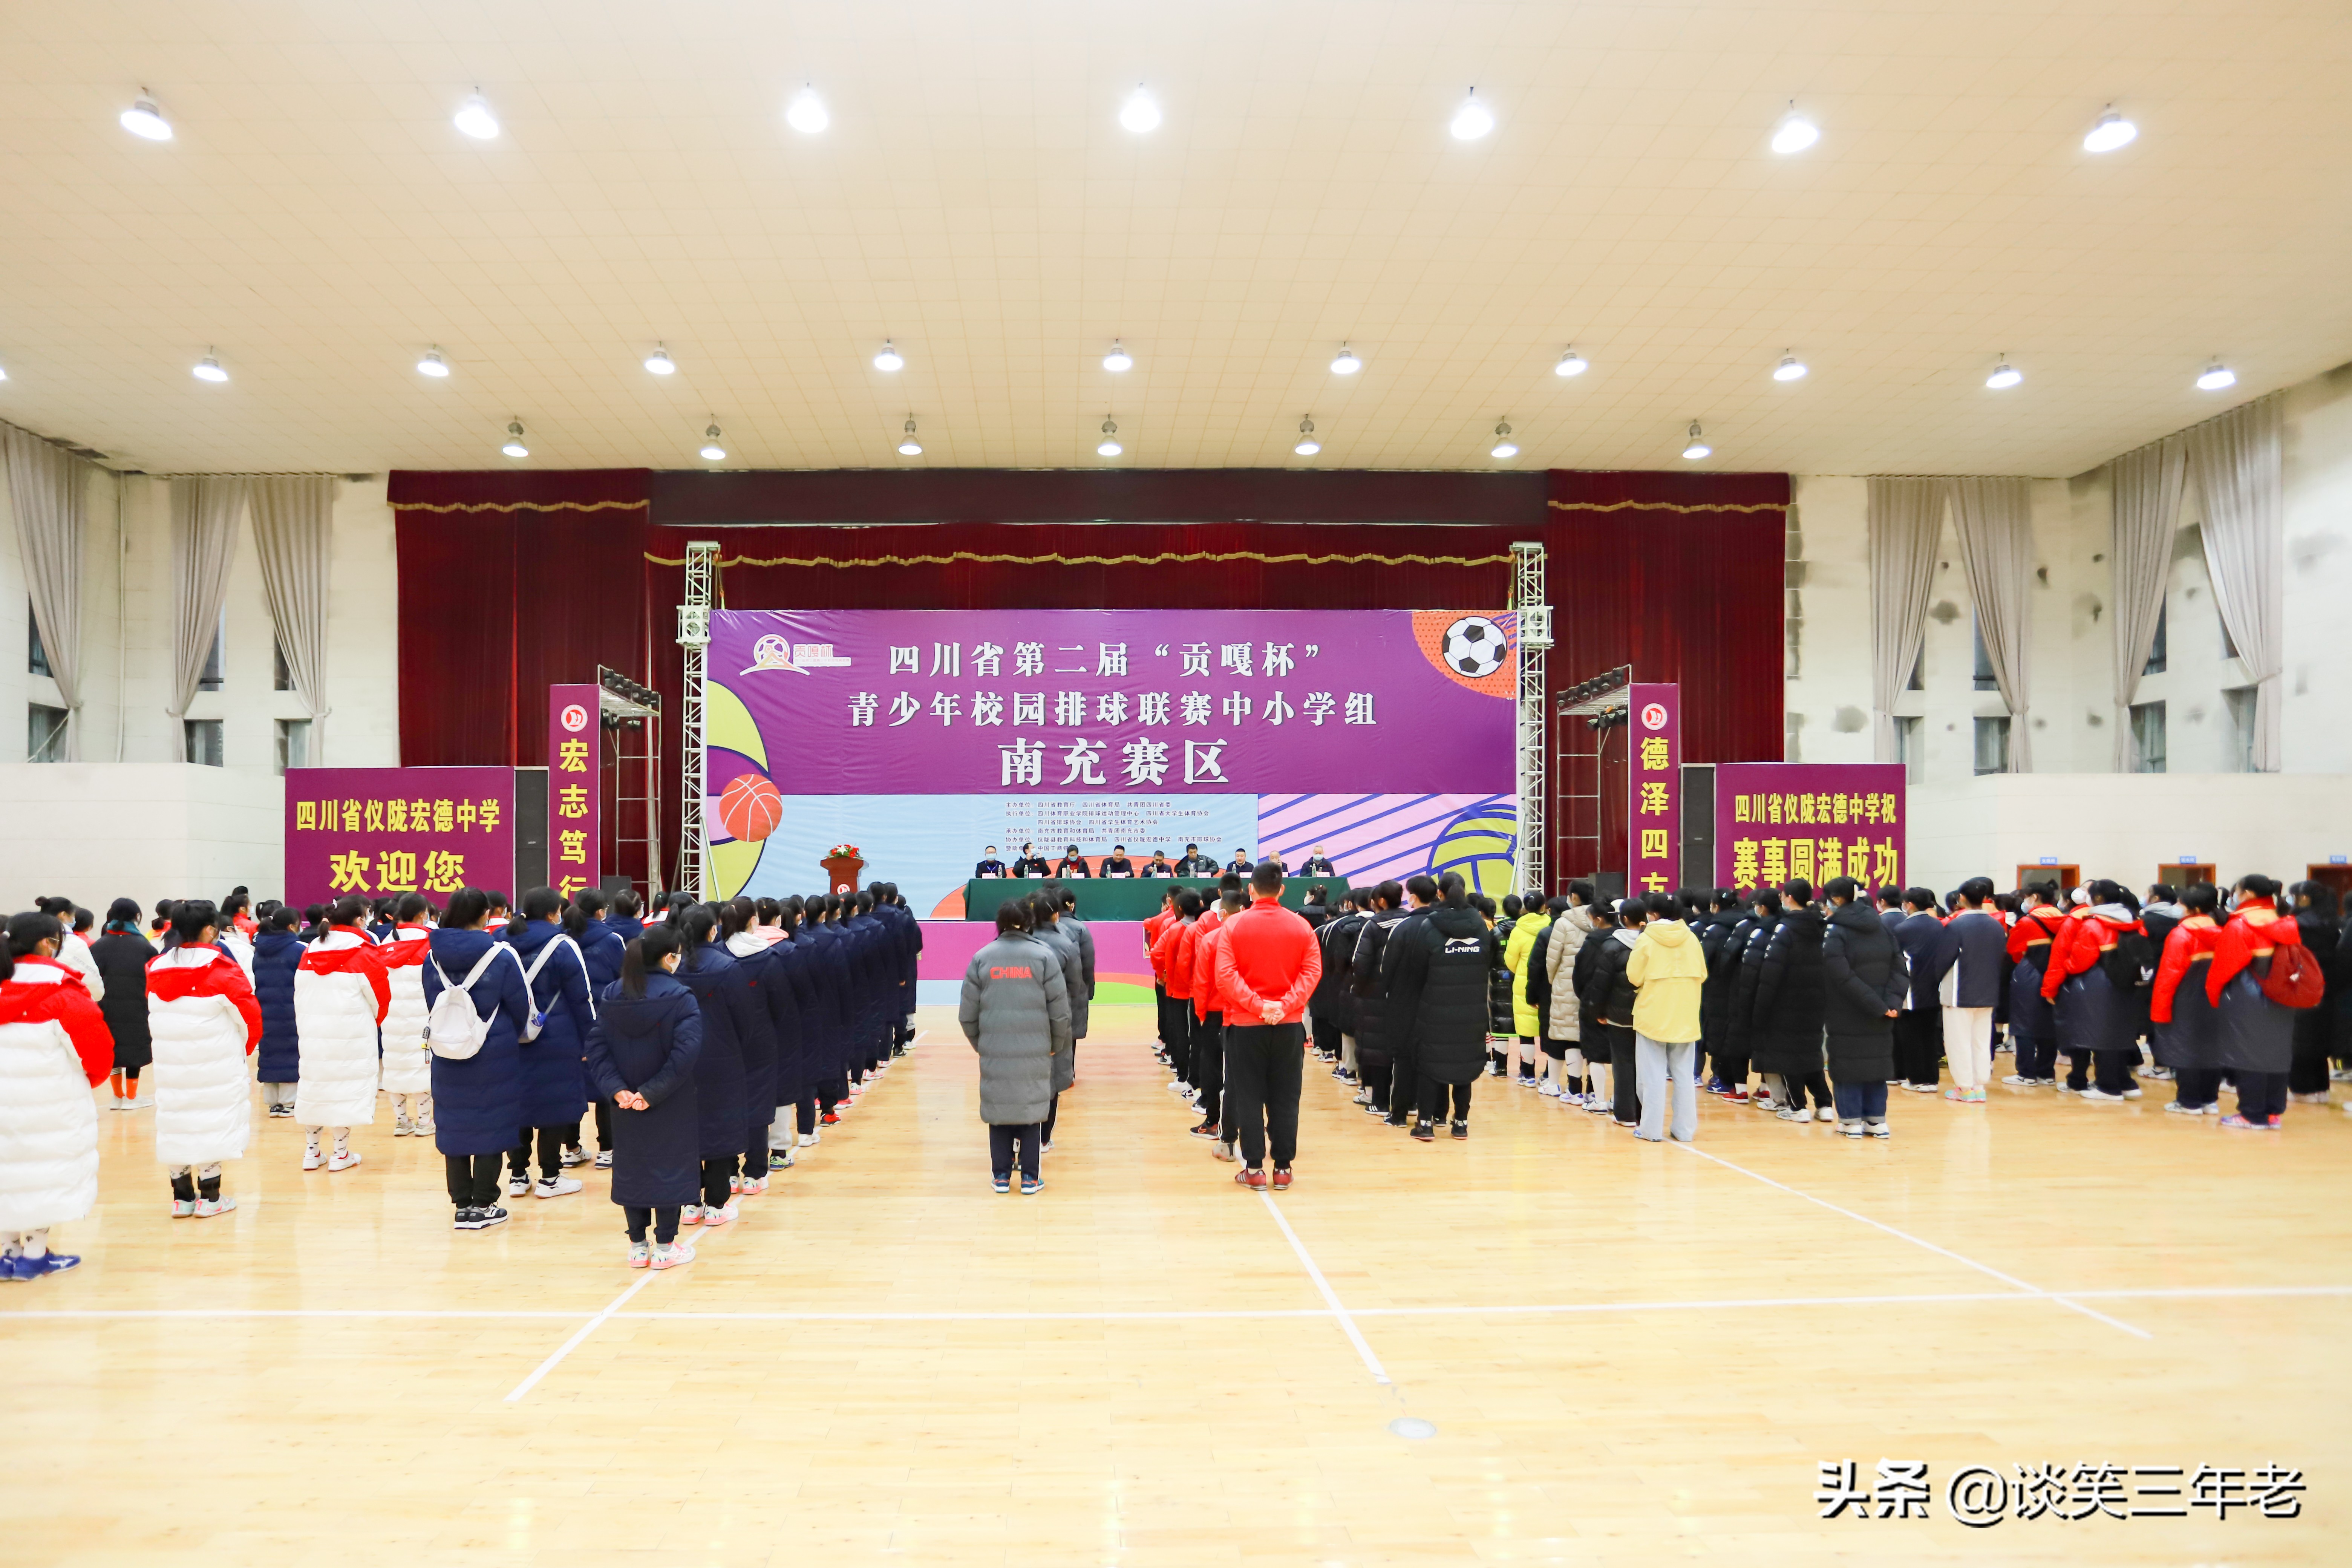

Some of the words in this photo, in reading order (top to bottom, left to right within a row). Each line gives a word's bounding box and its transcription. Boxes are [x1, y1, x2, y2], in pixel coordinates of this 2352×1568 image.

[795, 646, 832, 657] 贡嘎杯
[890, 642, 1319, 677] 四川省第二届“贡嘎杯”
[847, 690, 1377, 727] 青少年校园排球联赛中小学组
[997, 737, 1230, 786] 南充赛区
[297, 798, 500, 833] 四川省仪陇宏德中学
[1735, 793, 1896, 824] 四川省仪陇宏德中学祝
[329, 850, 465, 893] 欢迎您
[1733, 836, 1897, 890] 赛事圆满成功
[990, 966, 1032, 979] CHINA
